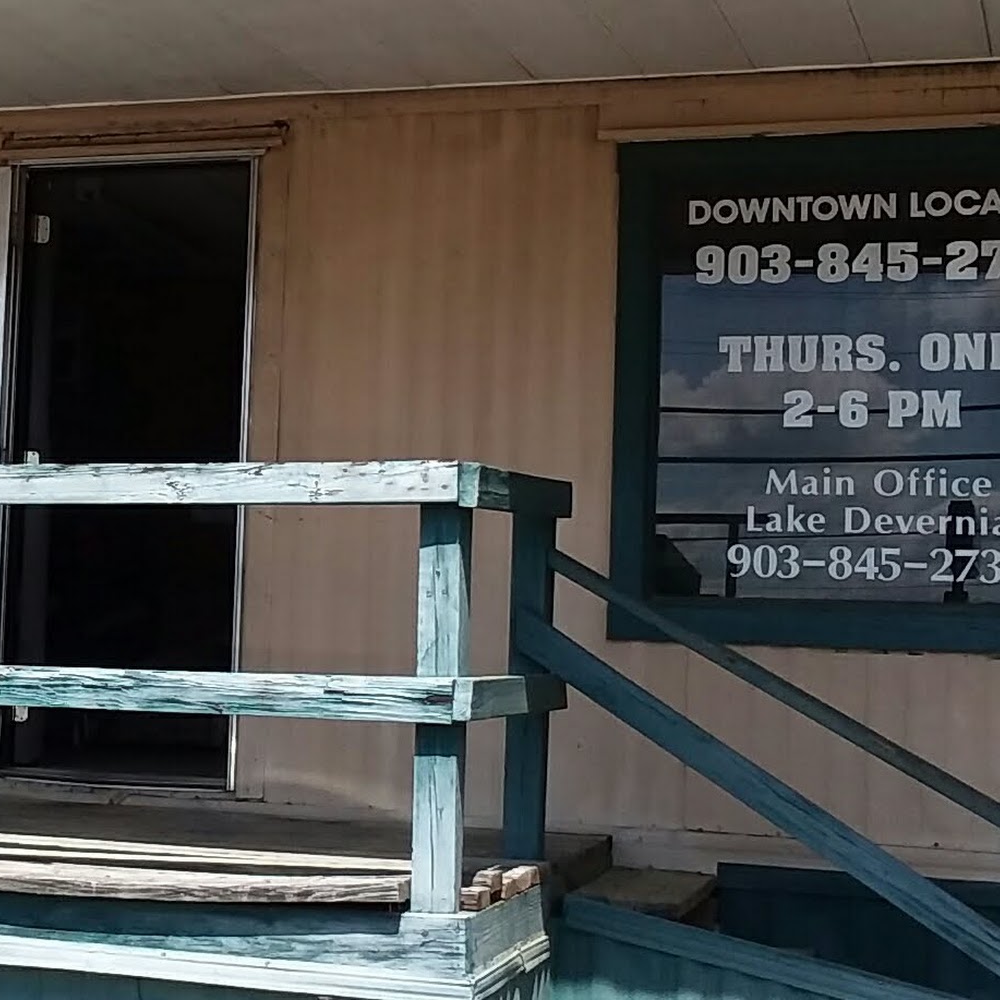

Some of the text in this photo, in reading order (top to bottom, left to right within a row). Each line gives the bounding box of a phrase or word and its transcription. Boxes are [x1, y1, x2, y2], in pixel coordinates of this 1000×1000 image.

[688, 192, 897, 225] DOWNTOWN
[695, 239, 1000, 285] 903-845-27
[718, 333, 901, 373] THURS.
[782, 389, 963, 429] 2-6 PM
[764, 467, 993, 498] Main Office
[746, 504, 827, 534] Lake
